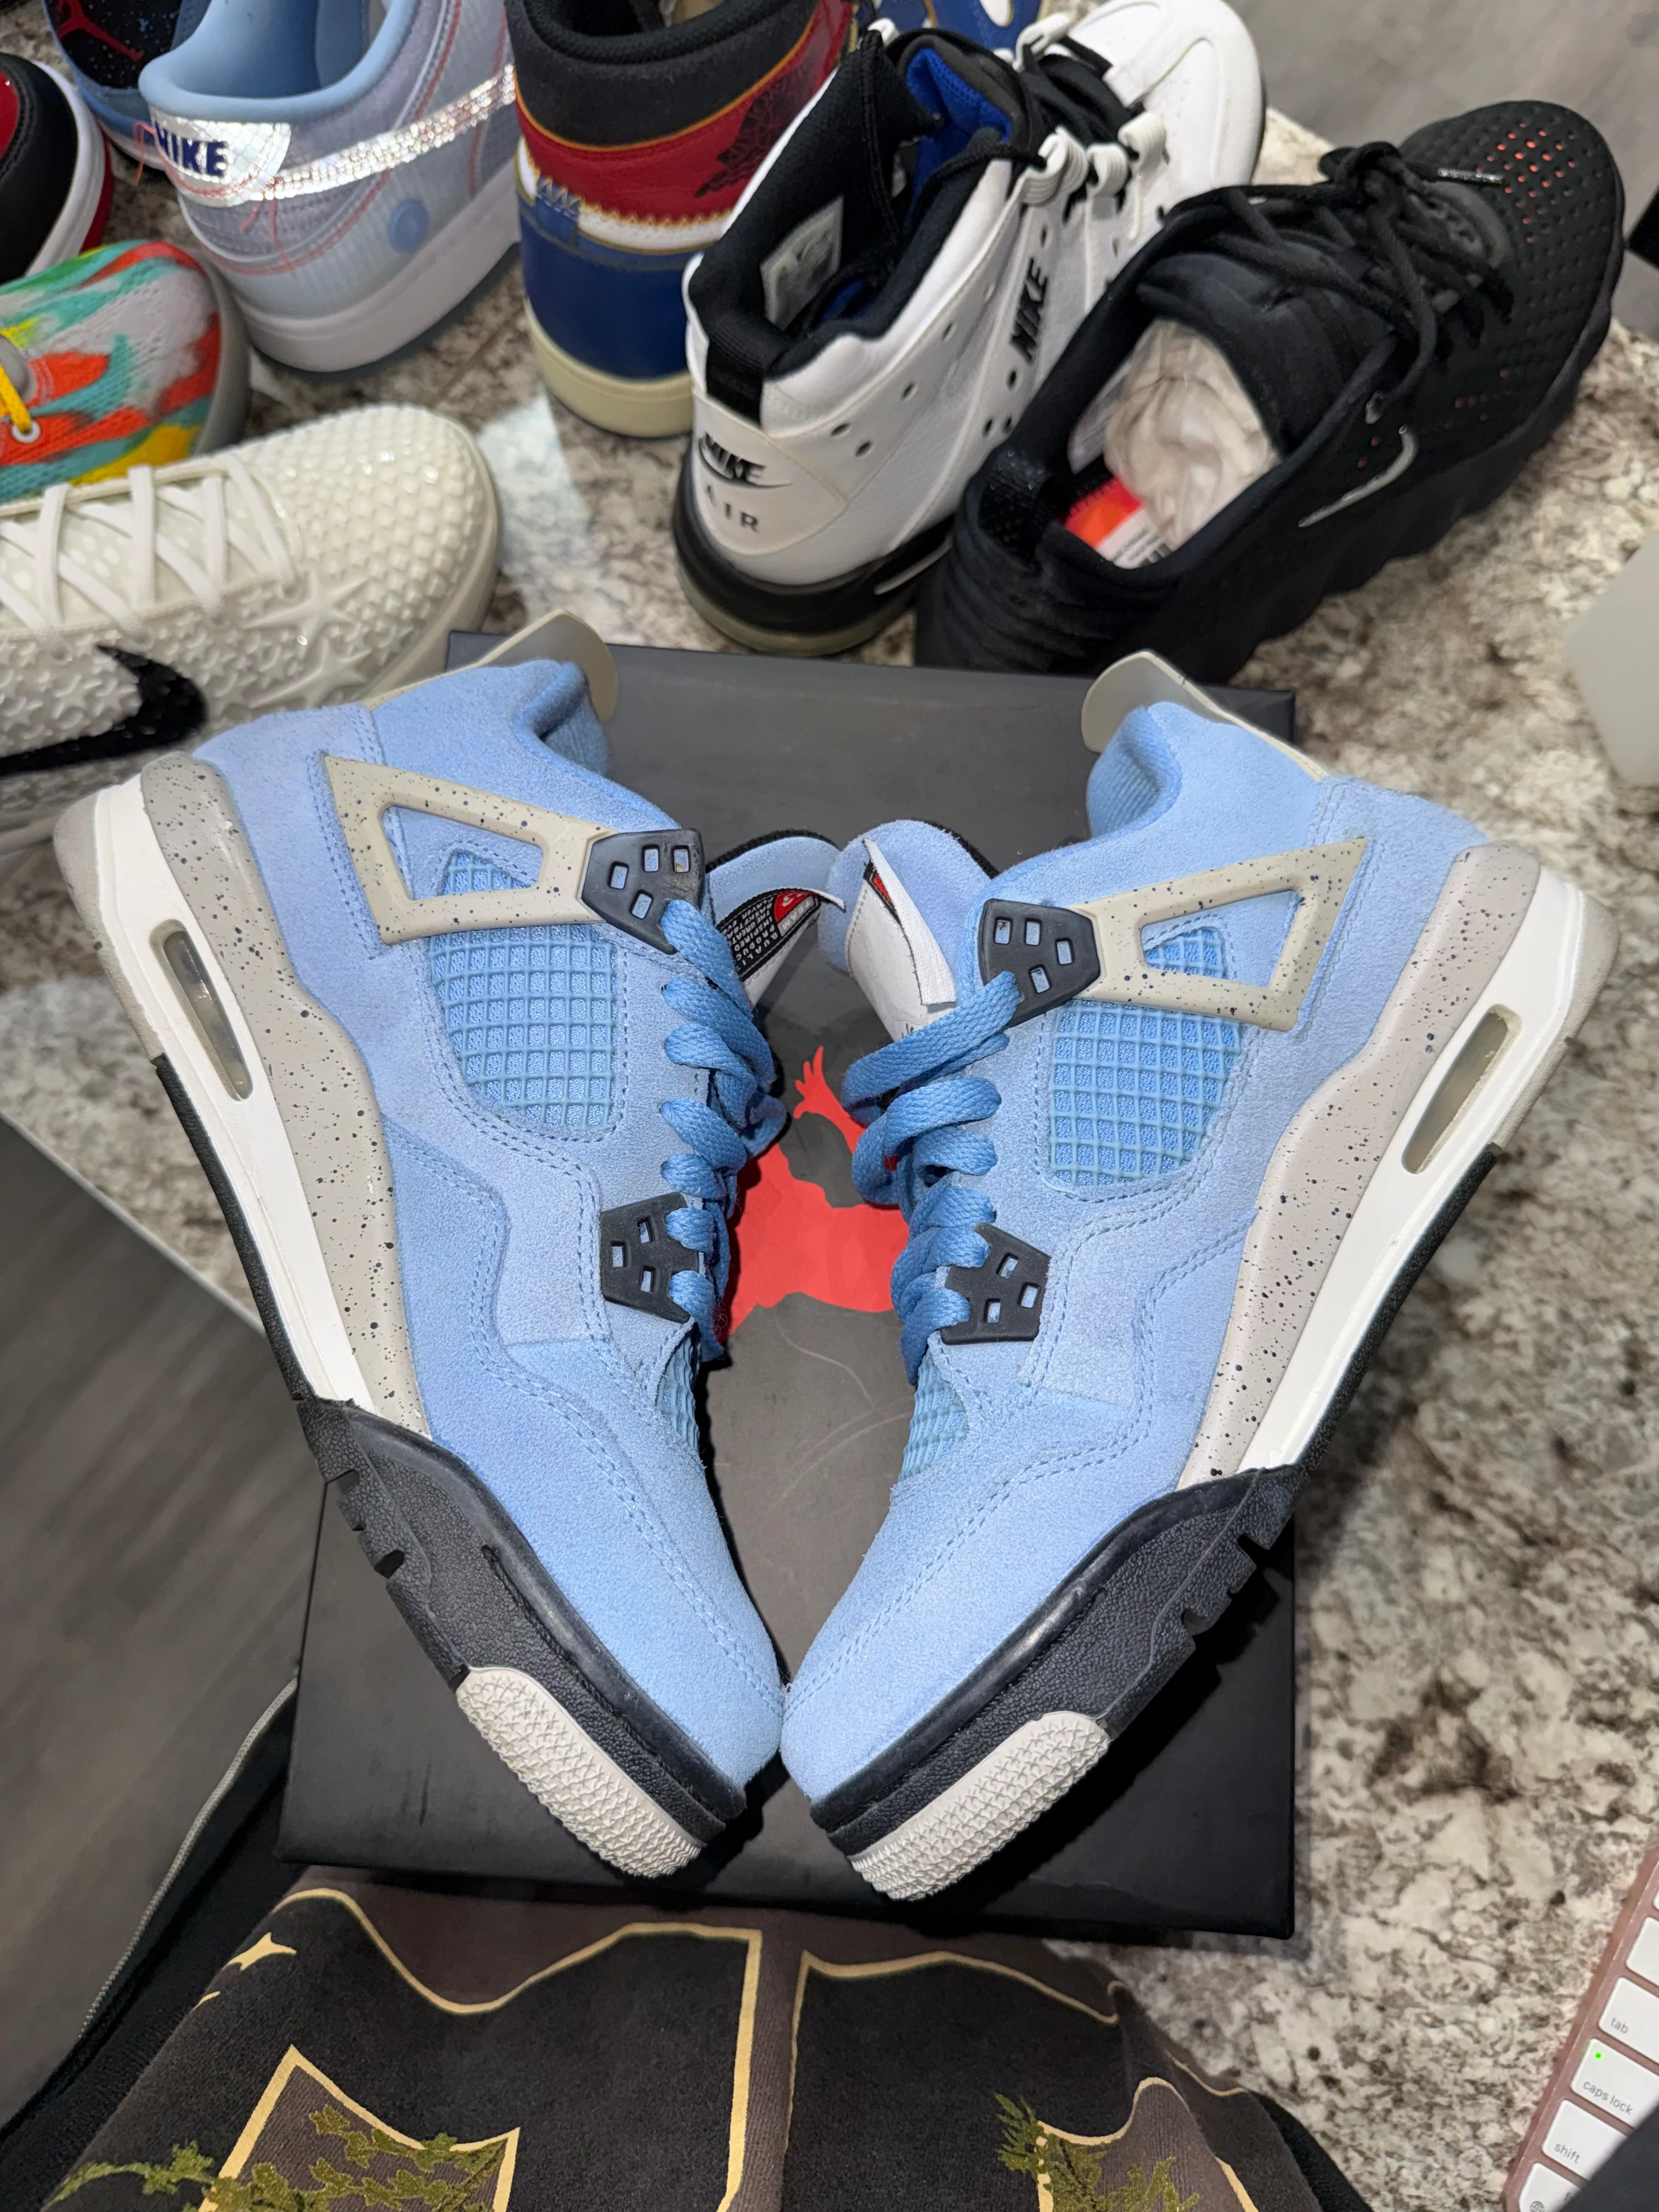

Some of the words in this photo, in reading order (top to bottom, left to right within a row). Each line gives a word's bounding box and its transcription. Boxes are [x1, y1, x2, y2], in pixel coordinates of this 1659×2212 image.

[155, 122, 227, 177] NIKE
[1010, 257, 1047, 364] NIKE
[705, 431, 767, 486] NIKE
[722, 920, 737, 936] EVE
[726, 902, 772, 939] BASKETBA
[756, 910, 770, 924] THE
[781, 900, 811, 930] TEAM
[733, 924, 775, 964] PRODUC
[734, 916, 772, 952] INSPIRED
[1610, 2017, 1629, 2034] tab
[1583, 2081, 1608, 2101] caps
[1610, 2095, 1633, 2116] lock
[1554, 2143, 1581, 2164] shift
